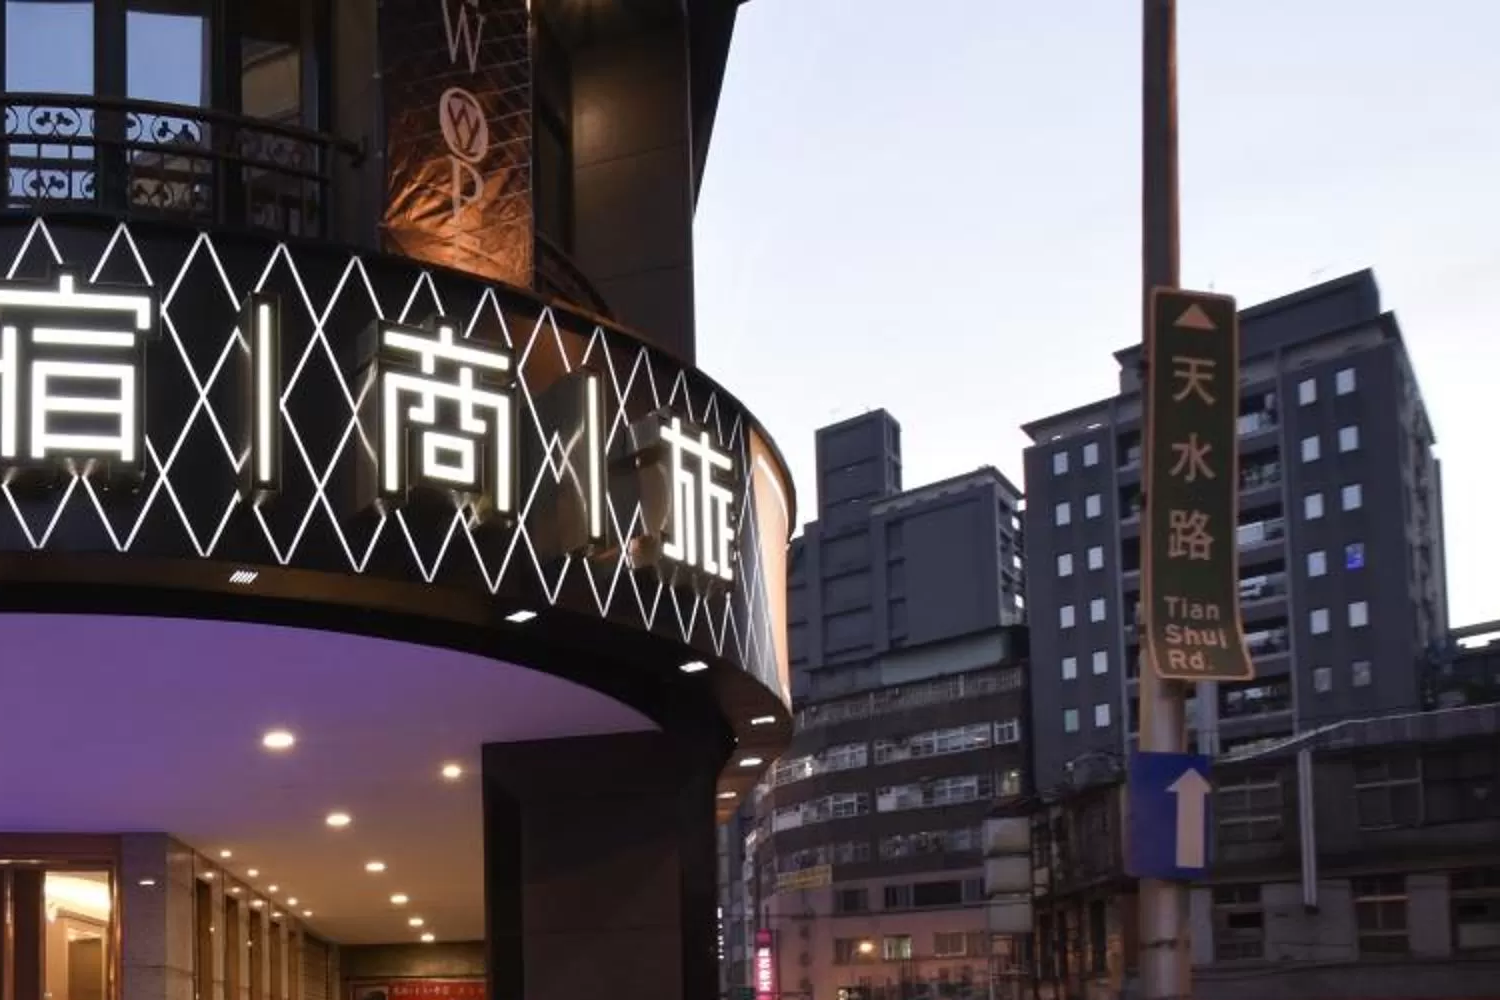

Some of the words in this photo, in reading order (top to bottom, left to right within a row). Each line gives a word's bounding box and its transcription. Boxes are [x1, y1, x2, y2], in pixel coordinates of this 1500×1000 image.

[1168, 355, 1217, 561] 天水路
[1163, 596, 1221, 621] Tian
[1164, 624, 1229, 649] Shui
[1167, 649, 1214, 671] Rd.
